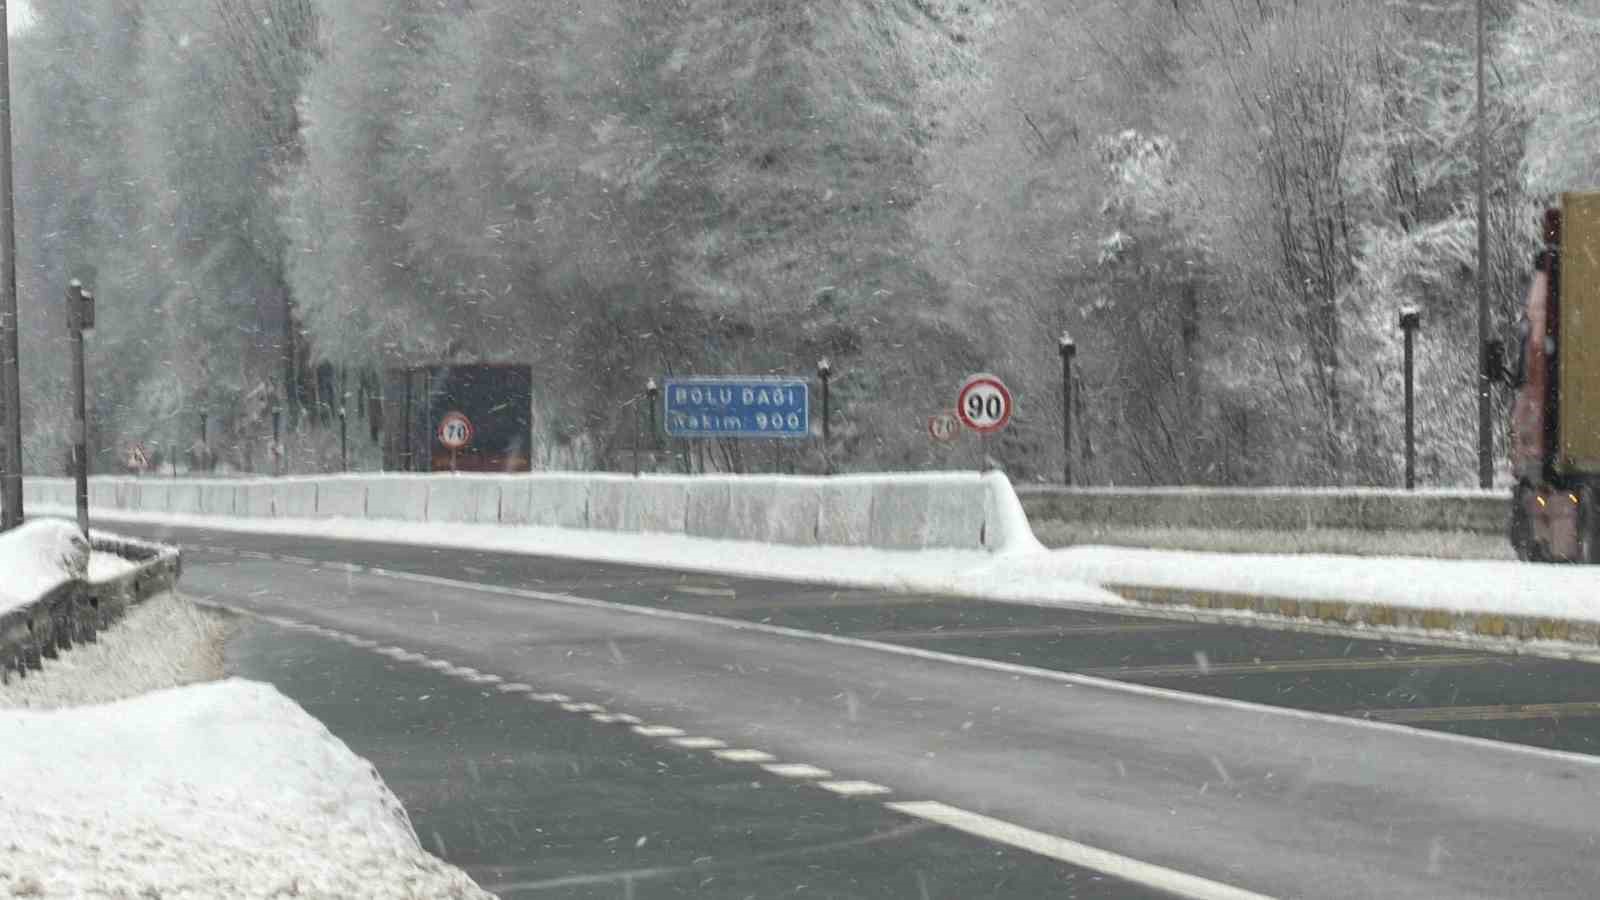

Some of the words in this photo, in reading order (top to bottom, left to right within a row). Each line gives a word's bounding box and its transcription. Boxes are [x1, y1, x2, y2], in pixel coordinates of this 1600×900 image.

[675, 386, 733, 405] BOLU
[968, 392, 1001, 419] 90
[756, 411, 799, 431] 900
[448, 424, 465, 441] 70
